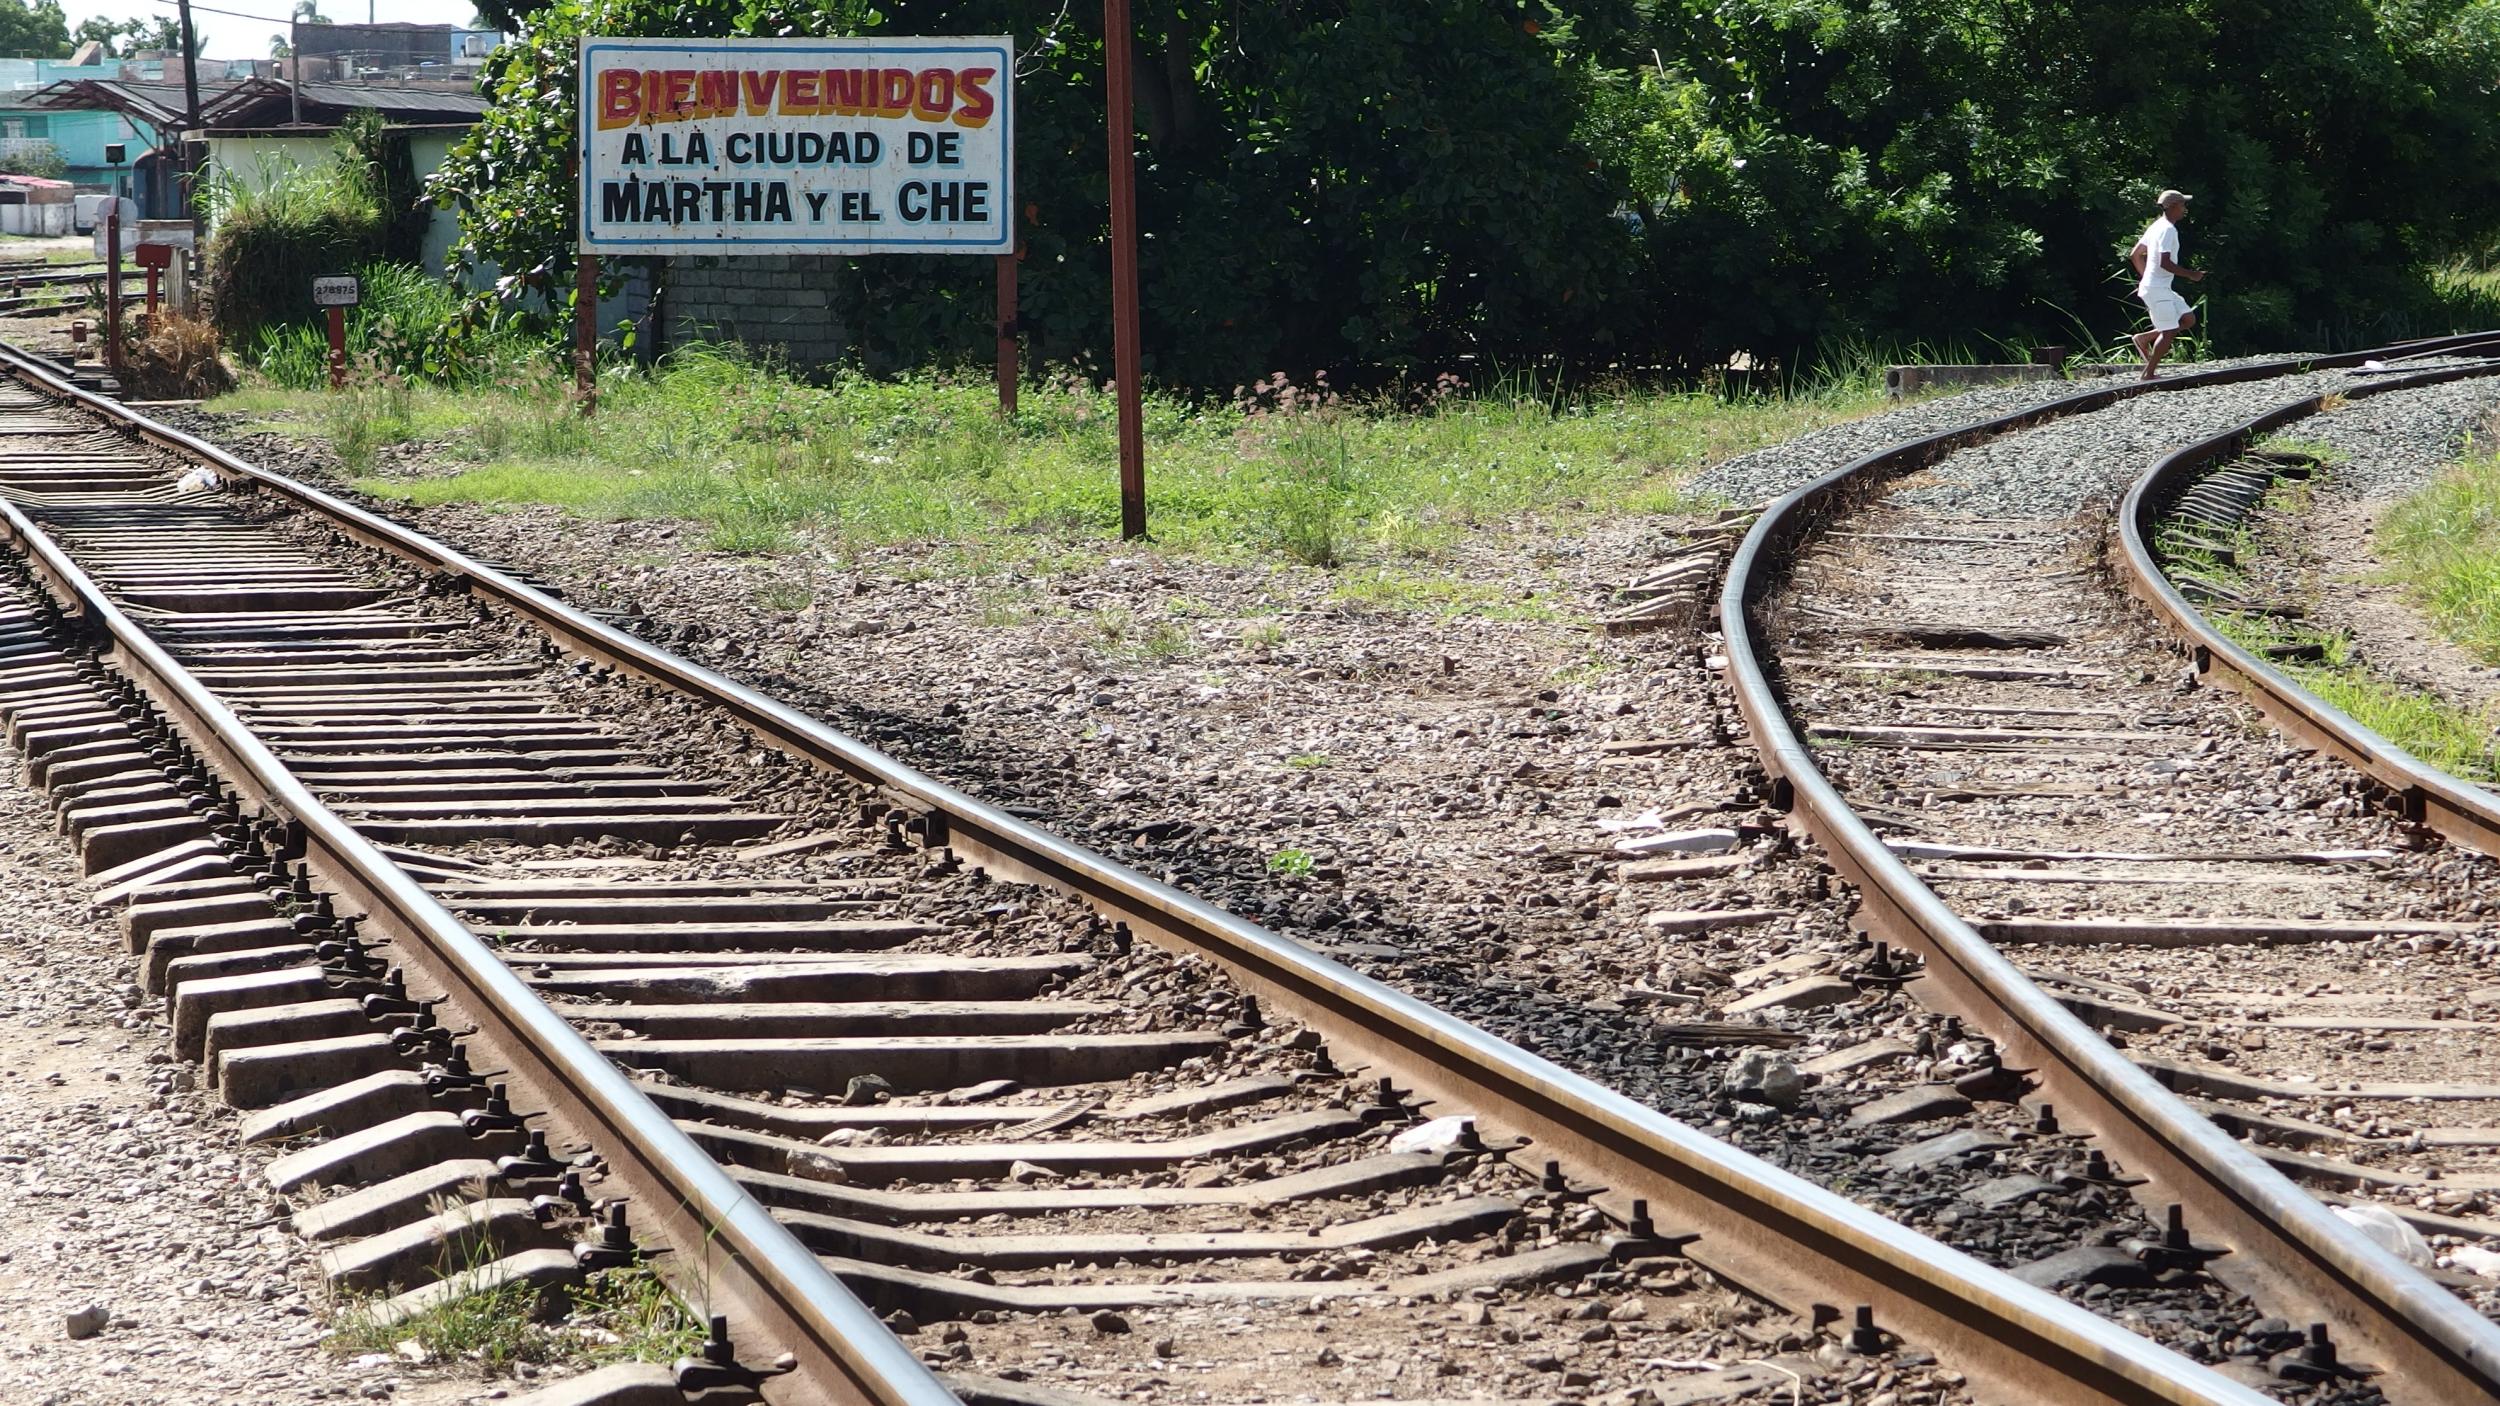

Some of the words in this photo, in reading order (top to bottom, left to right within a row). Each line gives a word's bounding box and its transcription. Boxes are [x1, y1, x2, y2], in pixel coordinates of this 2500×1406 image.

[598, 68, 996, 130] BIENVENIDOS
[621, 132, 647, 165] A
[661, 132, 710, 165] LA
[726, 132, 880, 164] CIUDAD
[908, 132, 960, 164] DE
[603, 182, 793, 222] MARTHA
[805, 192, 828, 221] Y
[842, 192, 881, 221] EL
[898, 181, 989, 222] CHE
